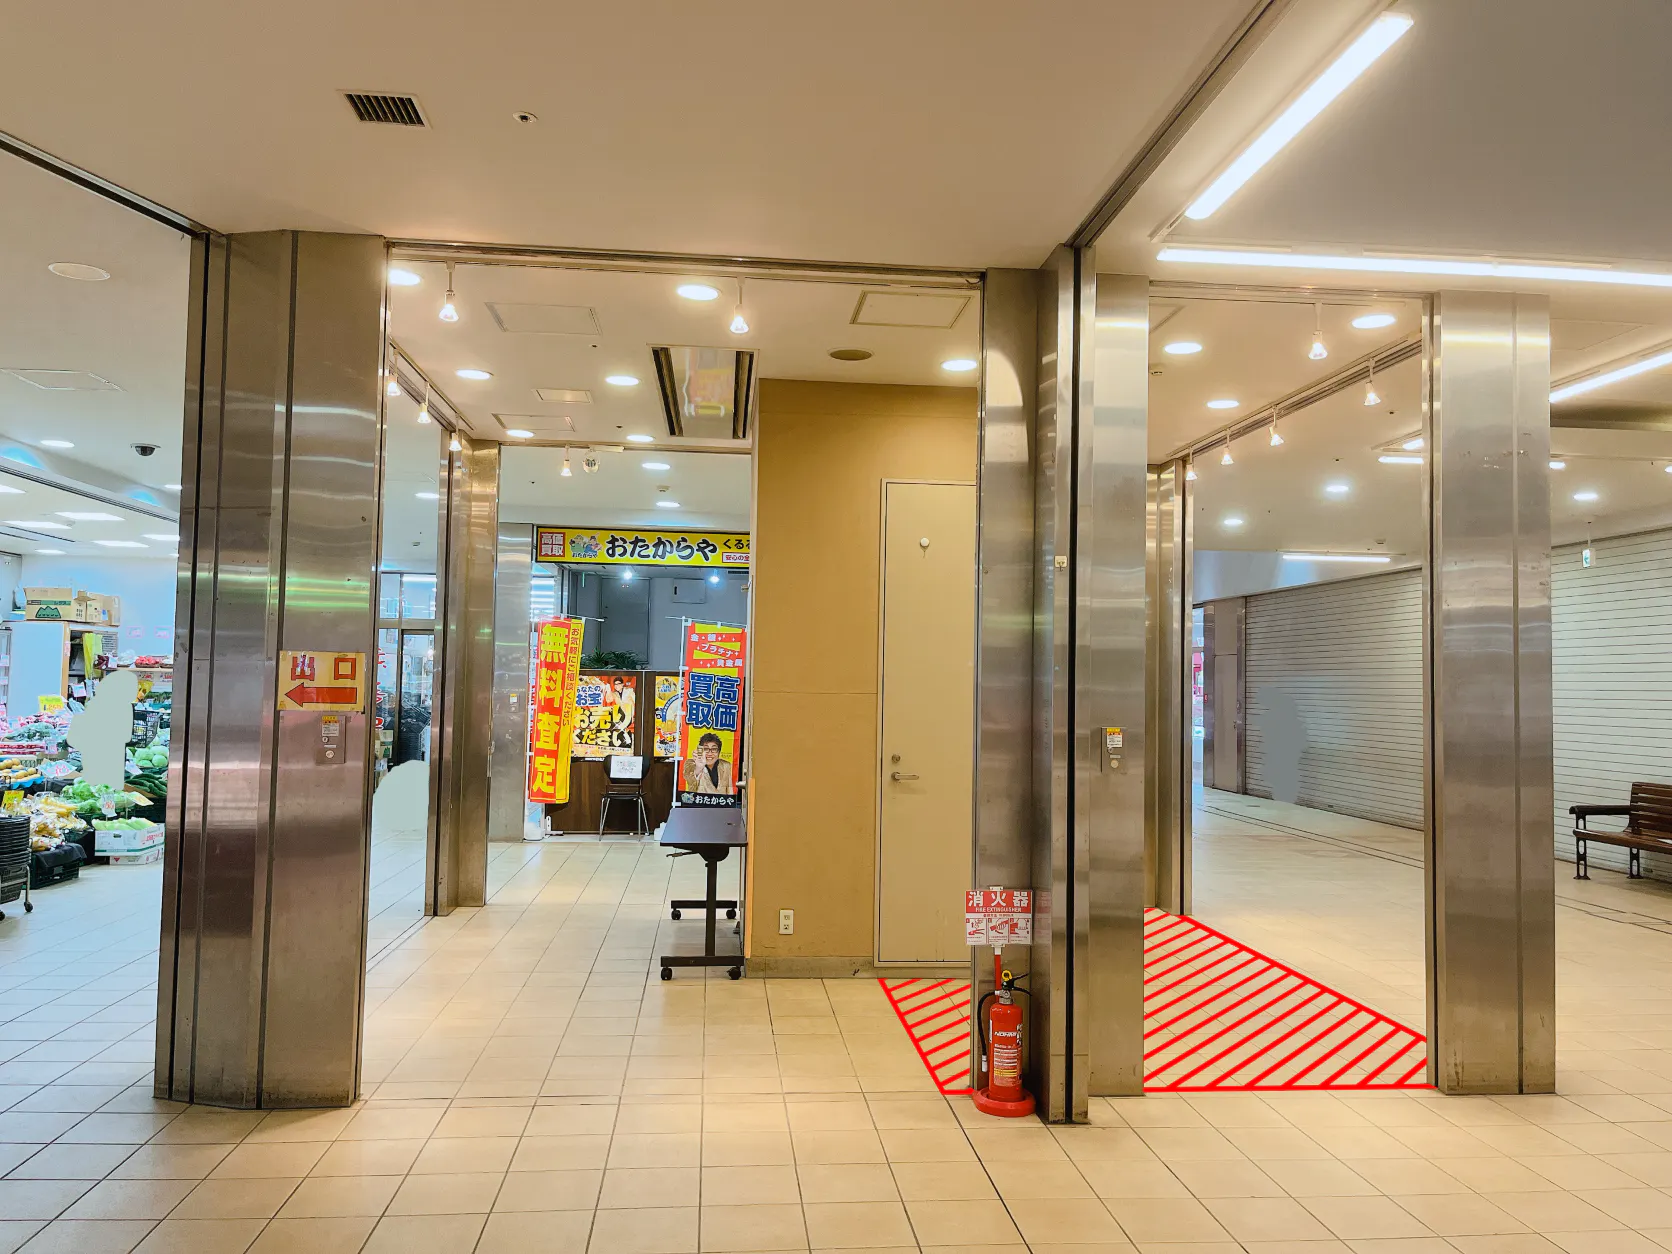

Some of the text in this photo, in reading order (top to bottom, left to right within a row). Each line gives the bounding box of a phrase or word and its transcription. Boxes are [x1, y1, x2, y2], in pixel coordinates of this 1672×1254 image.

[542, 533, 564, 544] 高価
[606, 534, 718, 562] おたからや
[290, 656, 357, 681] 出口
[532, 623, 569, 794] 無料査定
[576, 692, 602, 706] お宝
[686, 672, 714, 728] 買取
[714, 675, 740, 731] 高価
[572, 728, 632, 747] ください
[695, 795, 735, 806] おたからや
[968, 890, 1029, 907] 消火器
